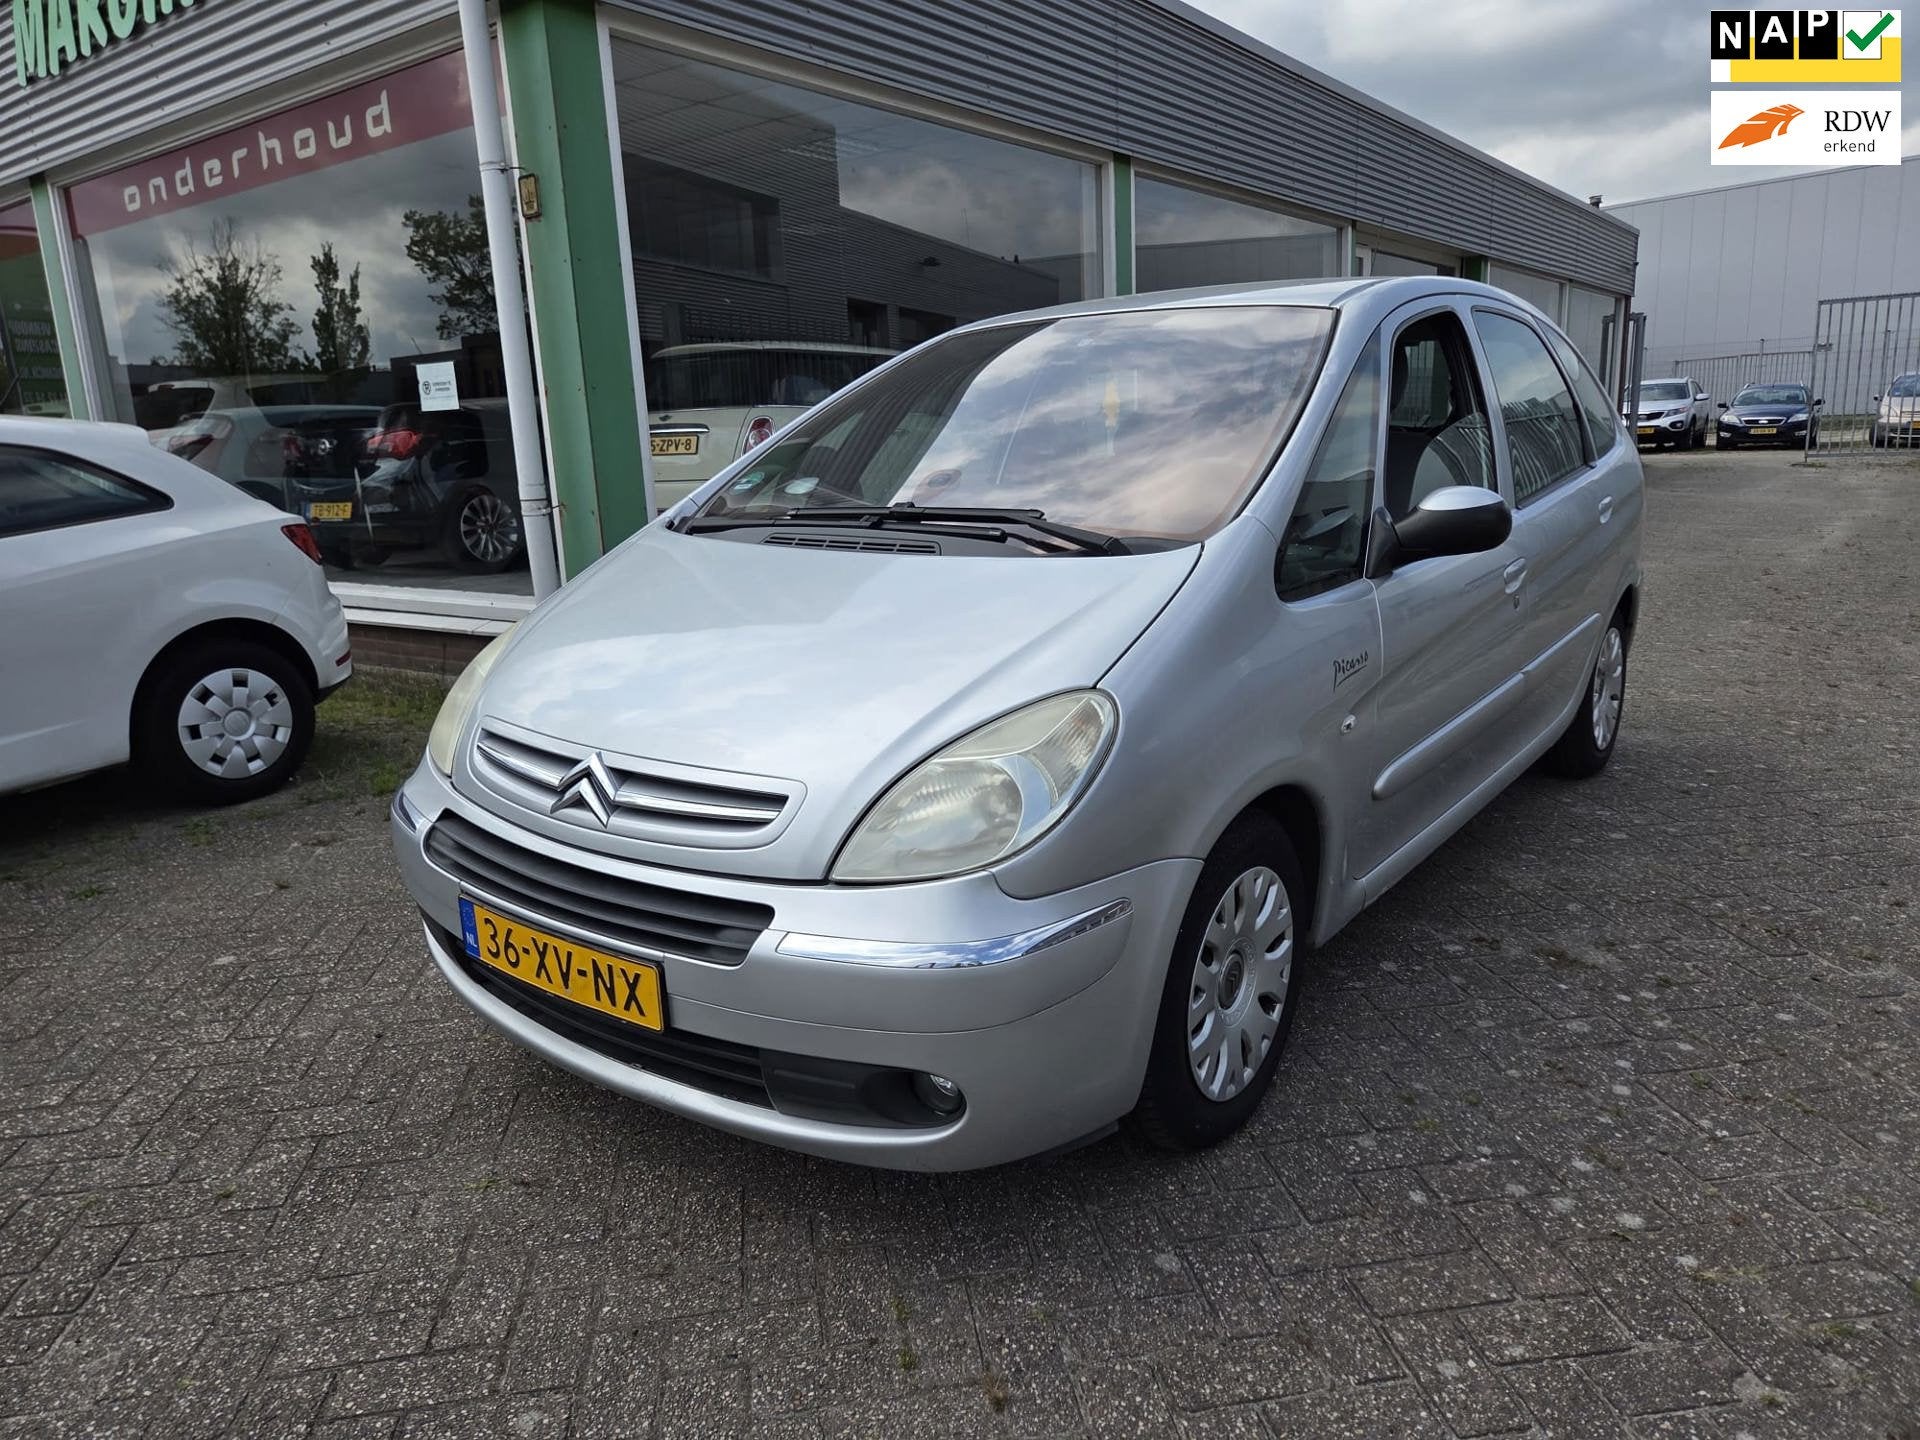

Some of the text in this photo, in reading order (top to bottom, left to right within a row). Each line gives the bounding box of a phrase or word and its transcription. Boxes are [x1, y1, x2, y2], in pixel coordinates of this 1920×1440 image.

[124, 89, 393, 212] onderhoud
[1333, 650, 1369, 692] Picasso
[465, 917, 646, 1017] NL 36-XV-NX
